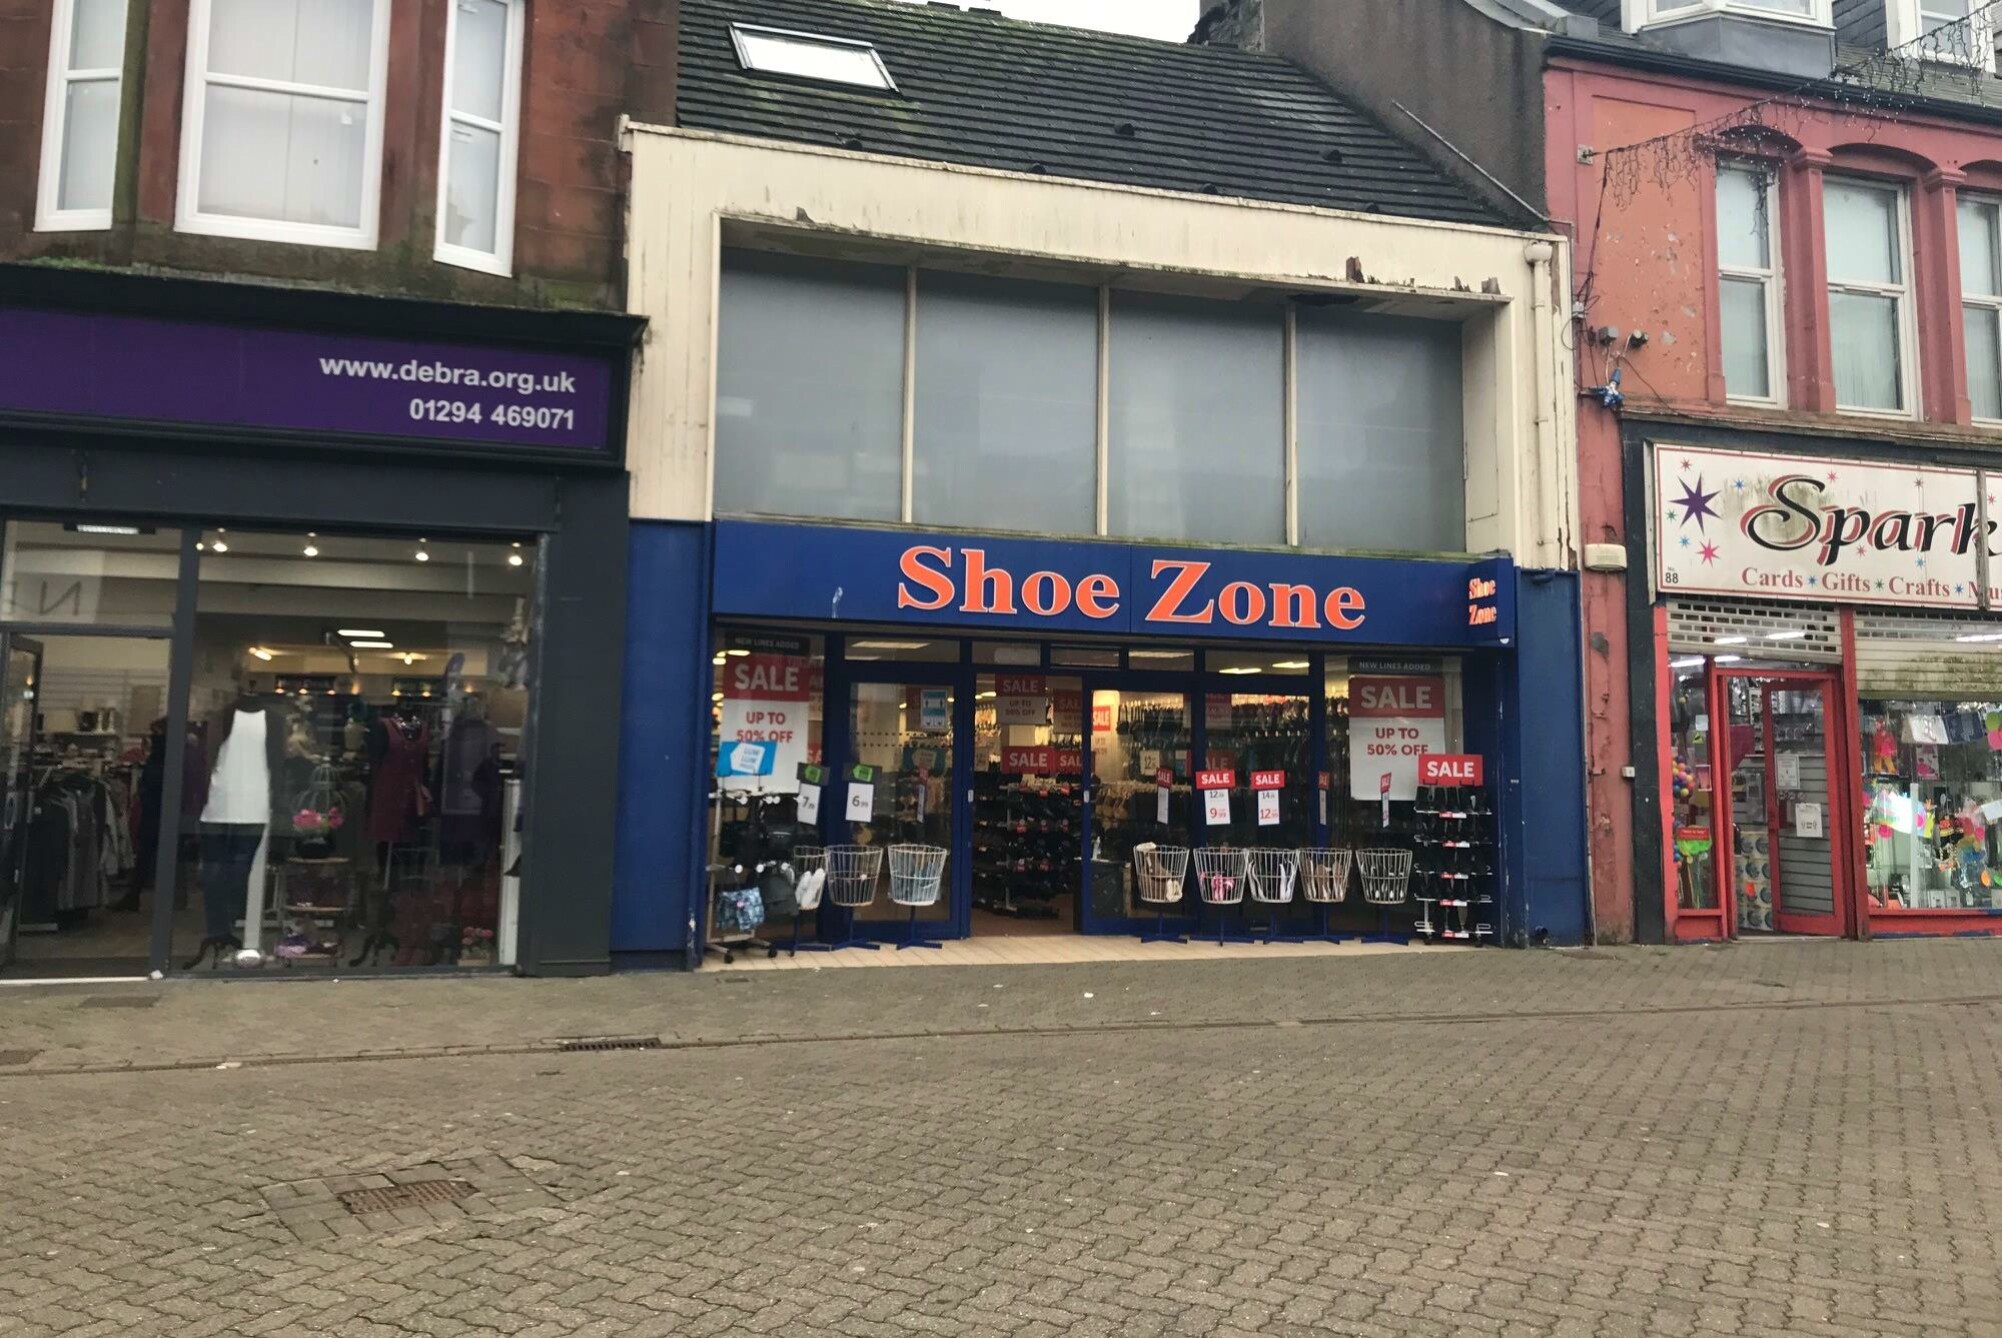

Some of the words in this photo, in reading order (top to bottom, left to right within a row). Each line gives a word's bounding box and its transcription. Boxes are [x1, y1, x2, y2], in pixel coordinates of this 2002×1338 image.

[319, 358, 576, 395] www.debra.org.uk
[409, 398, 483, 424] 01294
[490, 404, 575, 430] 469071
[1665, 572, 1679, 584] 88
[1741, 566, 1804, 588] Cards
[1822, 571, 1871, 592] Gifts
[1888, 575, 1951, 597] Crafts
[898, 545, 1120, 619] Shoe
[1145, 558, 1366, 630] Zone
[1469, 577, 1497, 600] Shoe
[1469, 604, 1498, 625] Zone
[1359, 661, 1377, 669] NEW
[1379, 662, 1401, 670] LINES
[1403, 663, 1431, 671] ADDED
[734, 662, 800, 692] SALE
[1003, 680, 1039, 694] SALE
[1360, 685, 1432, 710] SALE
[745, 711, 764, 725] UP
[768, 712, 786, 725] TO
[736, 729, 765, 743] 50%
[768, 731, 793, 744] OFF
[1375, 727, 1395, 740] UP
[1398, 727, 1420, 740] TO
[1367, 744, 1397, 756] 50%
[1401, 743, 1429, 756] OFF
[1008, 752, 1048, 768] SALE
[1060, 755, 1082, 768] SAL
[1427, 760, 1475, 778] SALE
[1201, 773, 1230, 785] SALE
[1255, 774, 1281, 786] SALE
